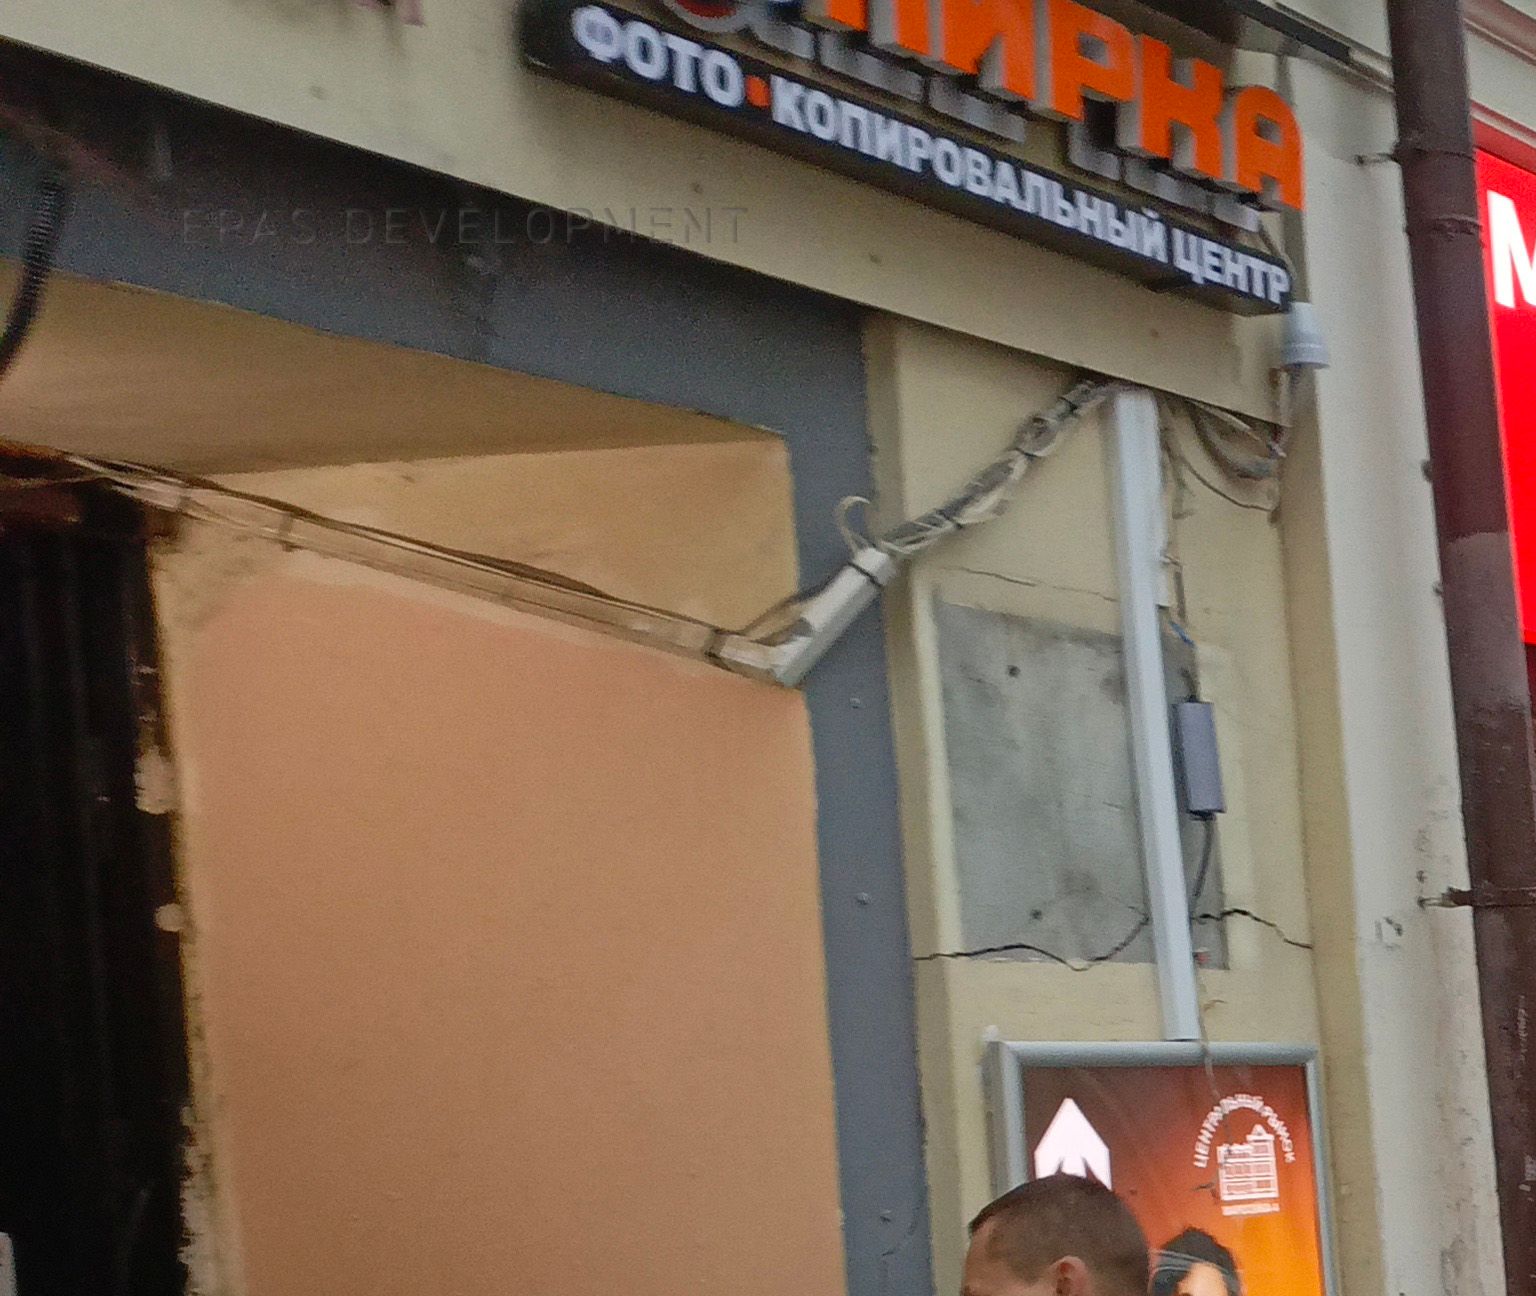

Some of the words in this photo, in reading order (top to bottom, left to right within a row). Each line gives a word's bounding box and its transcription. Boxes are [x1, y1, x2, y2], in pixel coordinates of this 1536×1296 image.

[571, 4, 745, 107] ФОТО
[770, 75, 1168, 264] КОПИРОВАЛЬНЫЙ
[1171, 227, 1291, 303] ЦЕНТР
